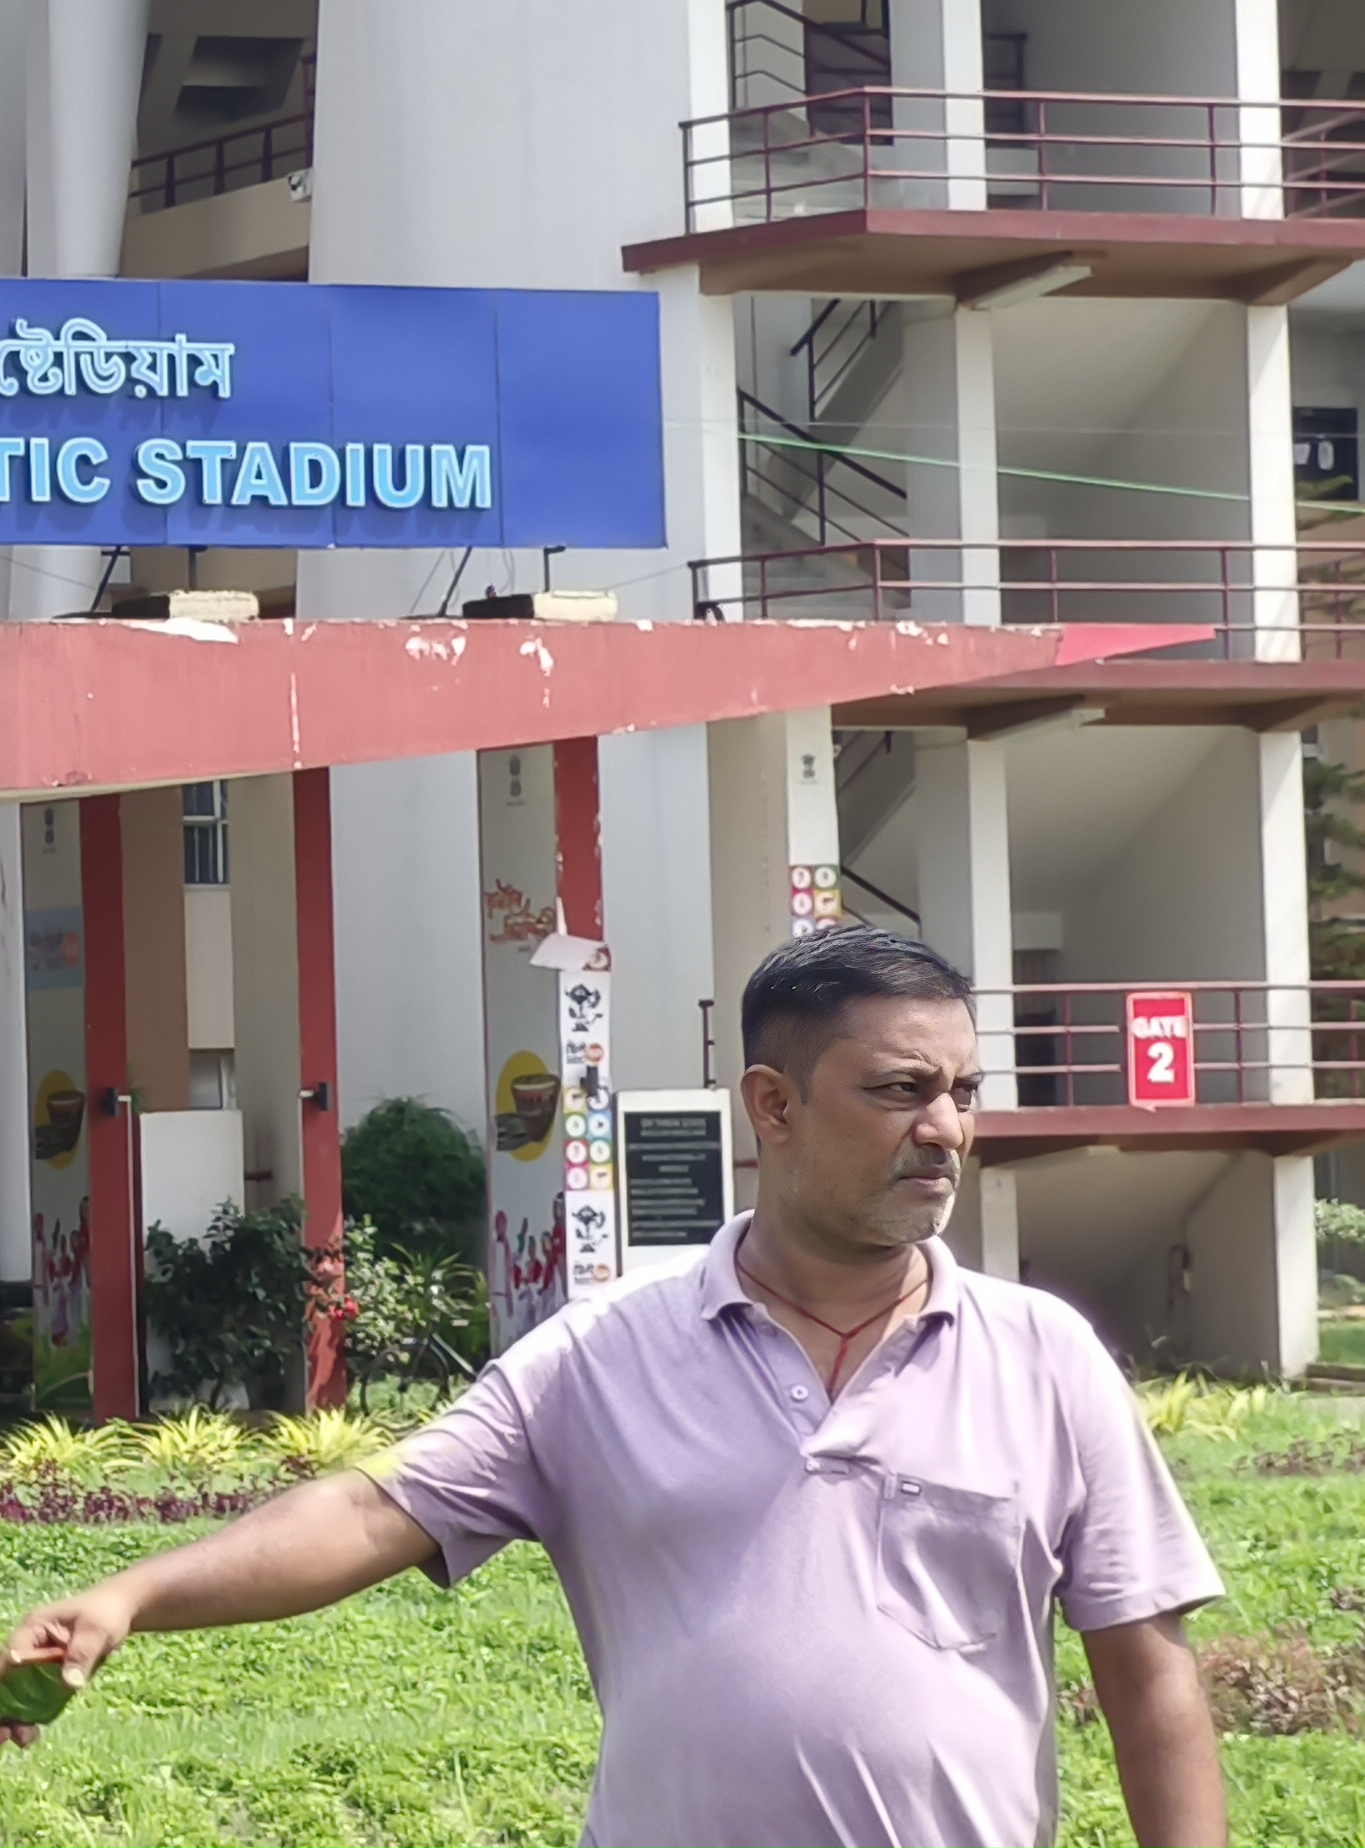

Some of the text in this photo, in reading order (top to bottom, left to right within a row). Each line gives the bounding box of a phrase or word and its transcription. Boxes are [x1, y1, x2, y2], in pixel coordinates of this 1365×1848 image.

[136, 437, 493, 509] STADIUM
[1130, 1014, 1190, 1040] GATE
[1146, 1041, 1175, 1084] 2
